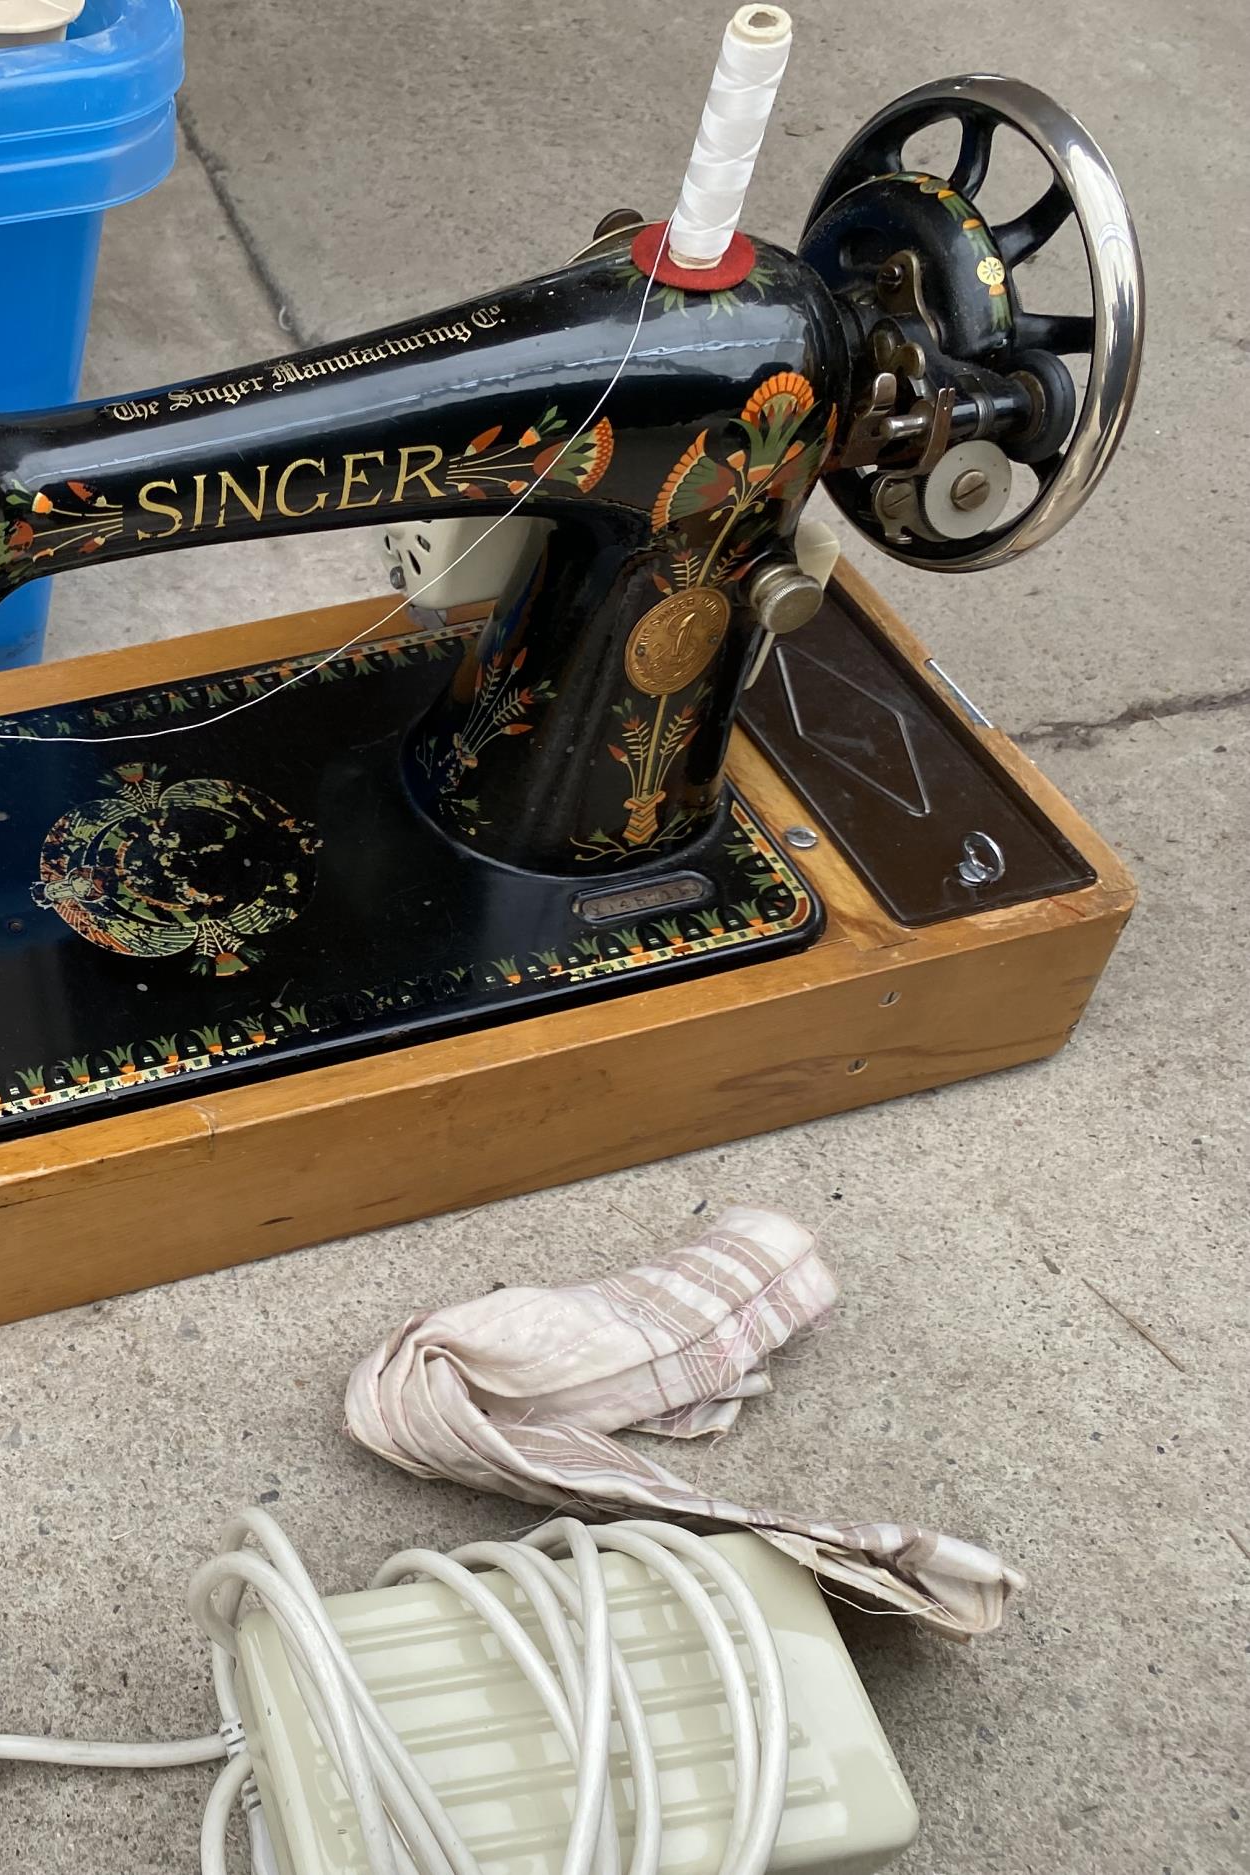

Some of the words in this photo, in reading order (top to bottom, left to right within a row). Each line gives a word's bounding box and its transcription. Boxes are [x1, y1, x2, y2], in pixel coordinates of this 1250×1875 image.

[104, 402, 160, 421] The
[168, 377, 264, 412] Singer
[265, 319, 472, 392] Manufacturing
[137, 445, 447, 541] SINGER
